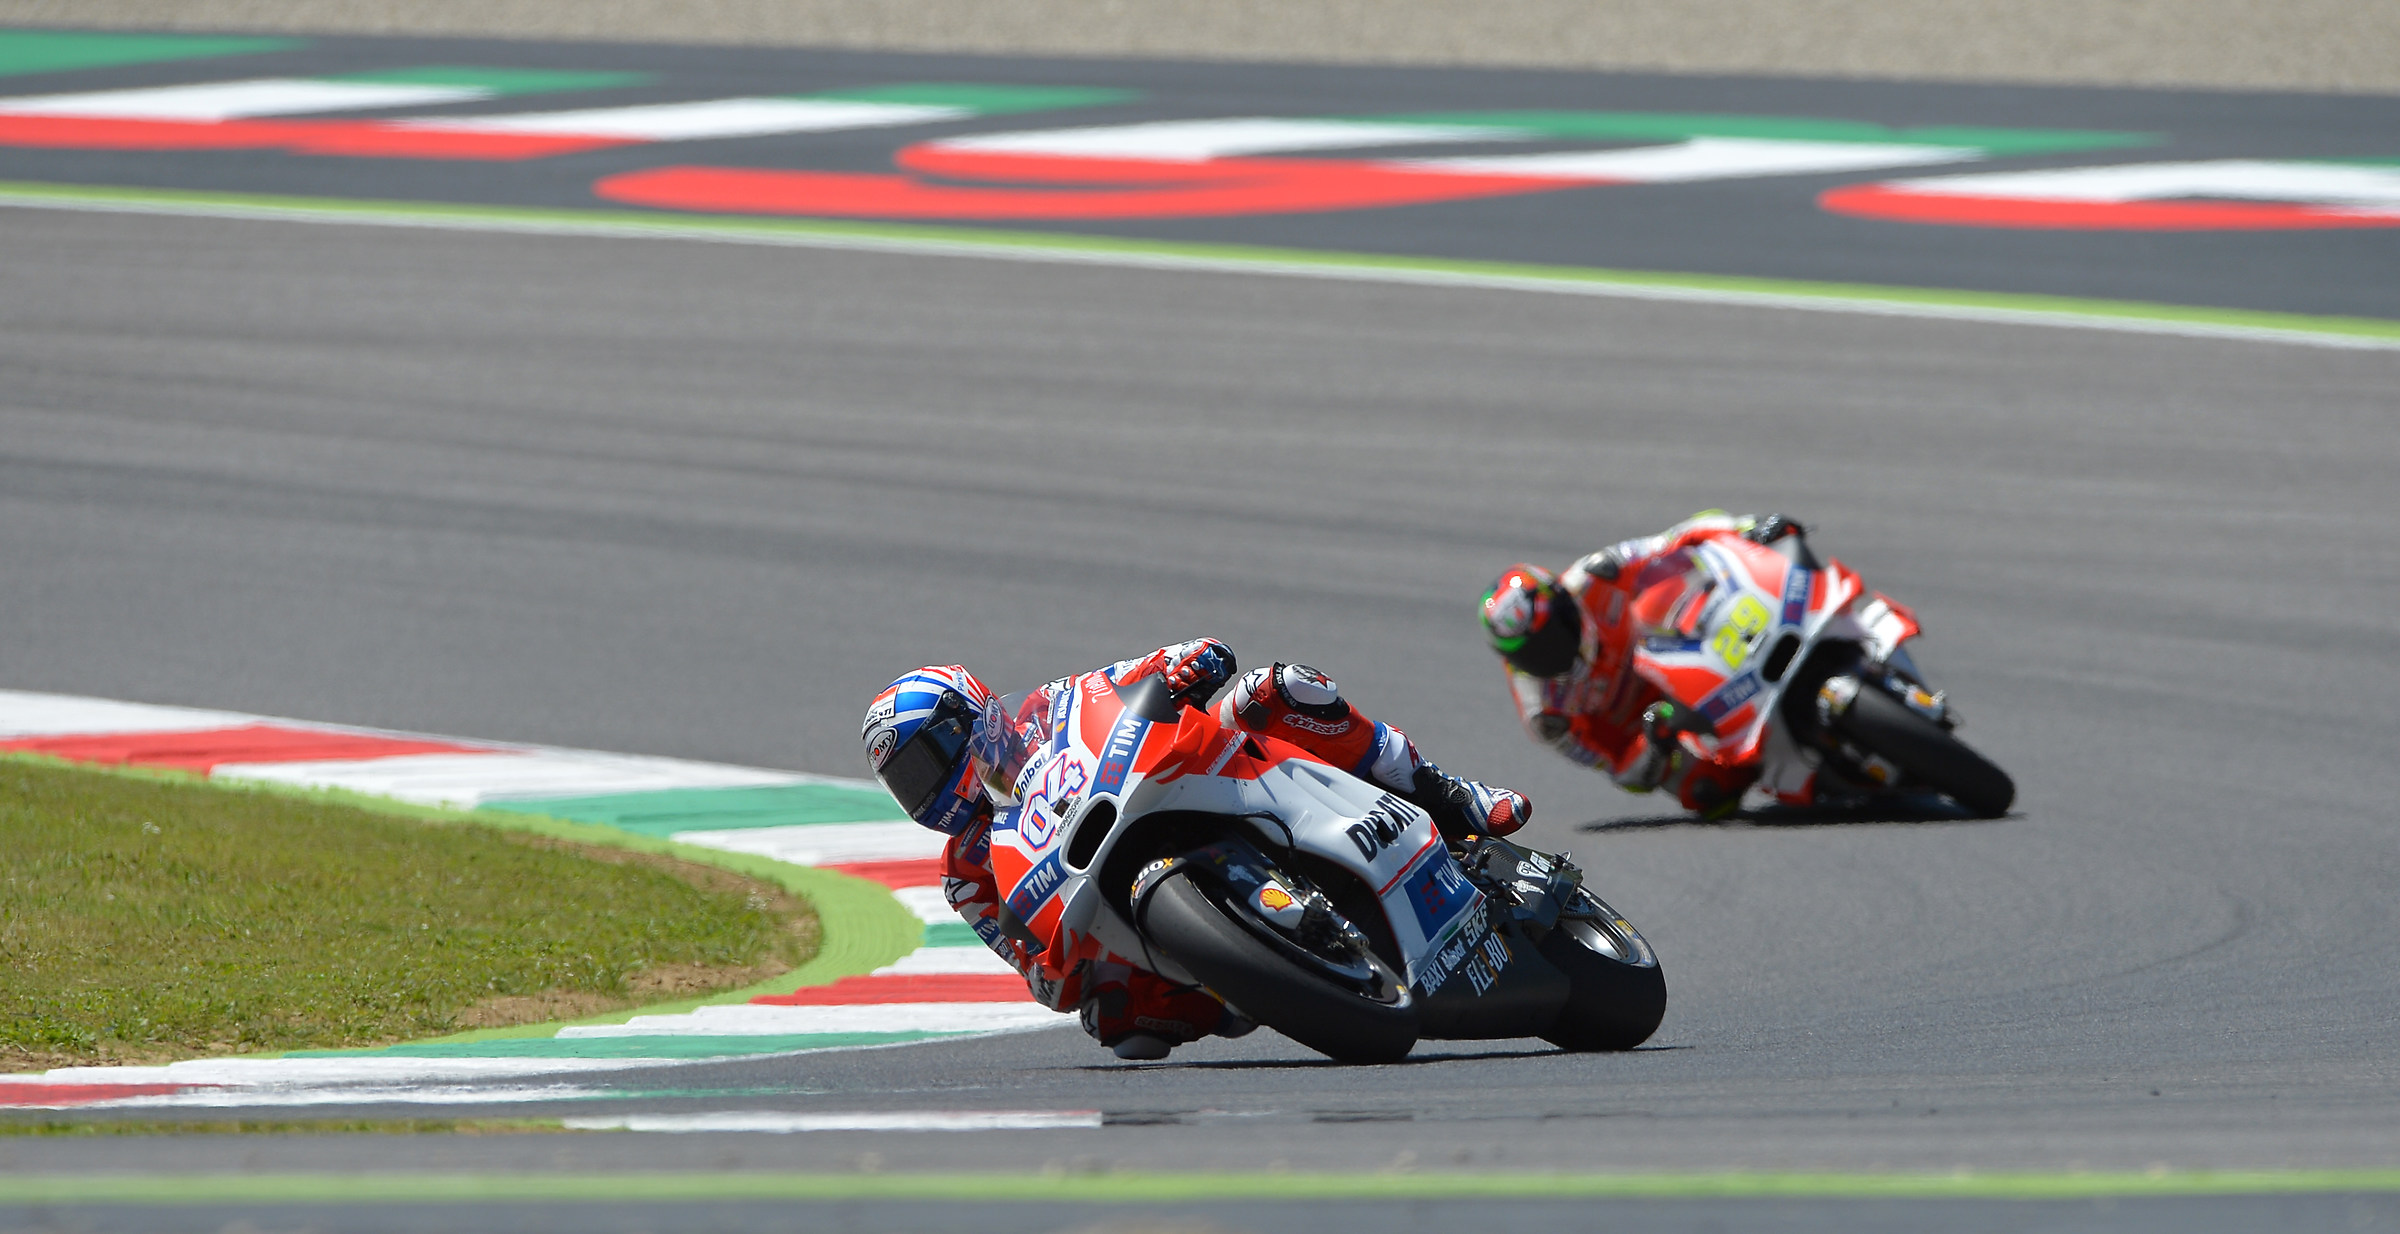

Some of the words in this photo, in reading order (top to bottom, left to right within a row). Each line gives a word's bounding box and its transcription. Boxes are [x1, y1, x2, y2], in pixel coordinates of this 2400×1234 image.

[1713, 595, 1770, 670] 29
[1108, 718, 1143, 758] TIM
[1283, 713, 1349, 736] alpinestars
[938, 812, 955, 829] TIM
[1021, 753, 1088, 852] 04
[977, 825, 992, 850] TI
[1345, 793, 1420, 862] DUCATI
[1024, 861, 1058, 900] TIM
[1435, 858, 1464, 894] TIM
[977, 918, 998, 940] TIM
[1420, 960, 1447, 997] BAXI
[1464, 902, 1488, 947] SKF
